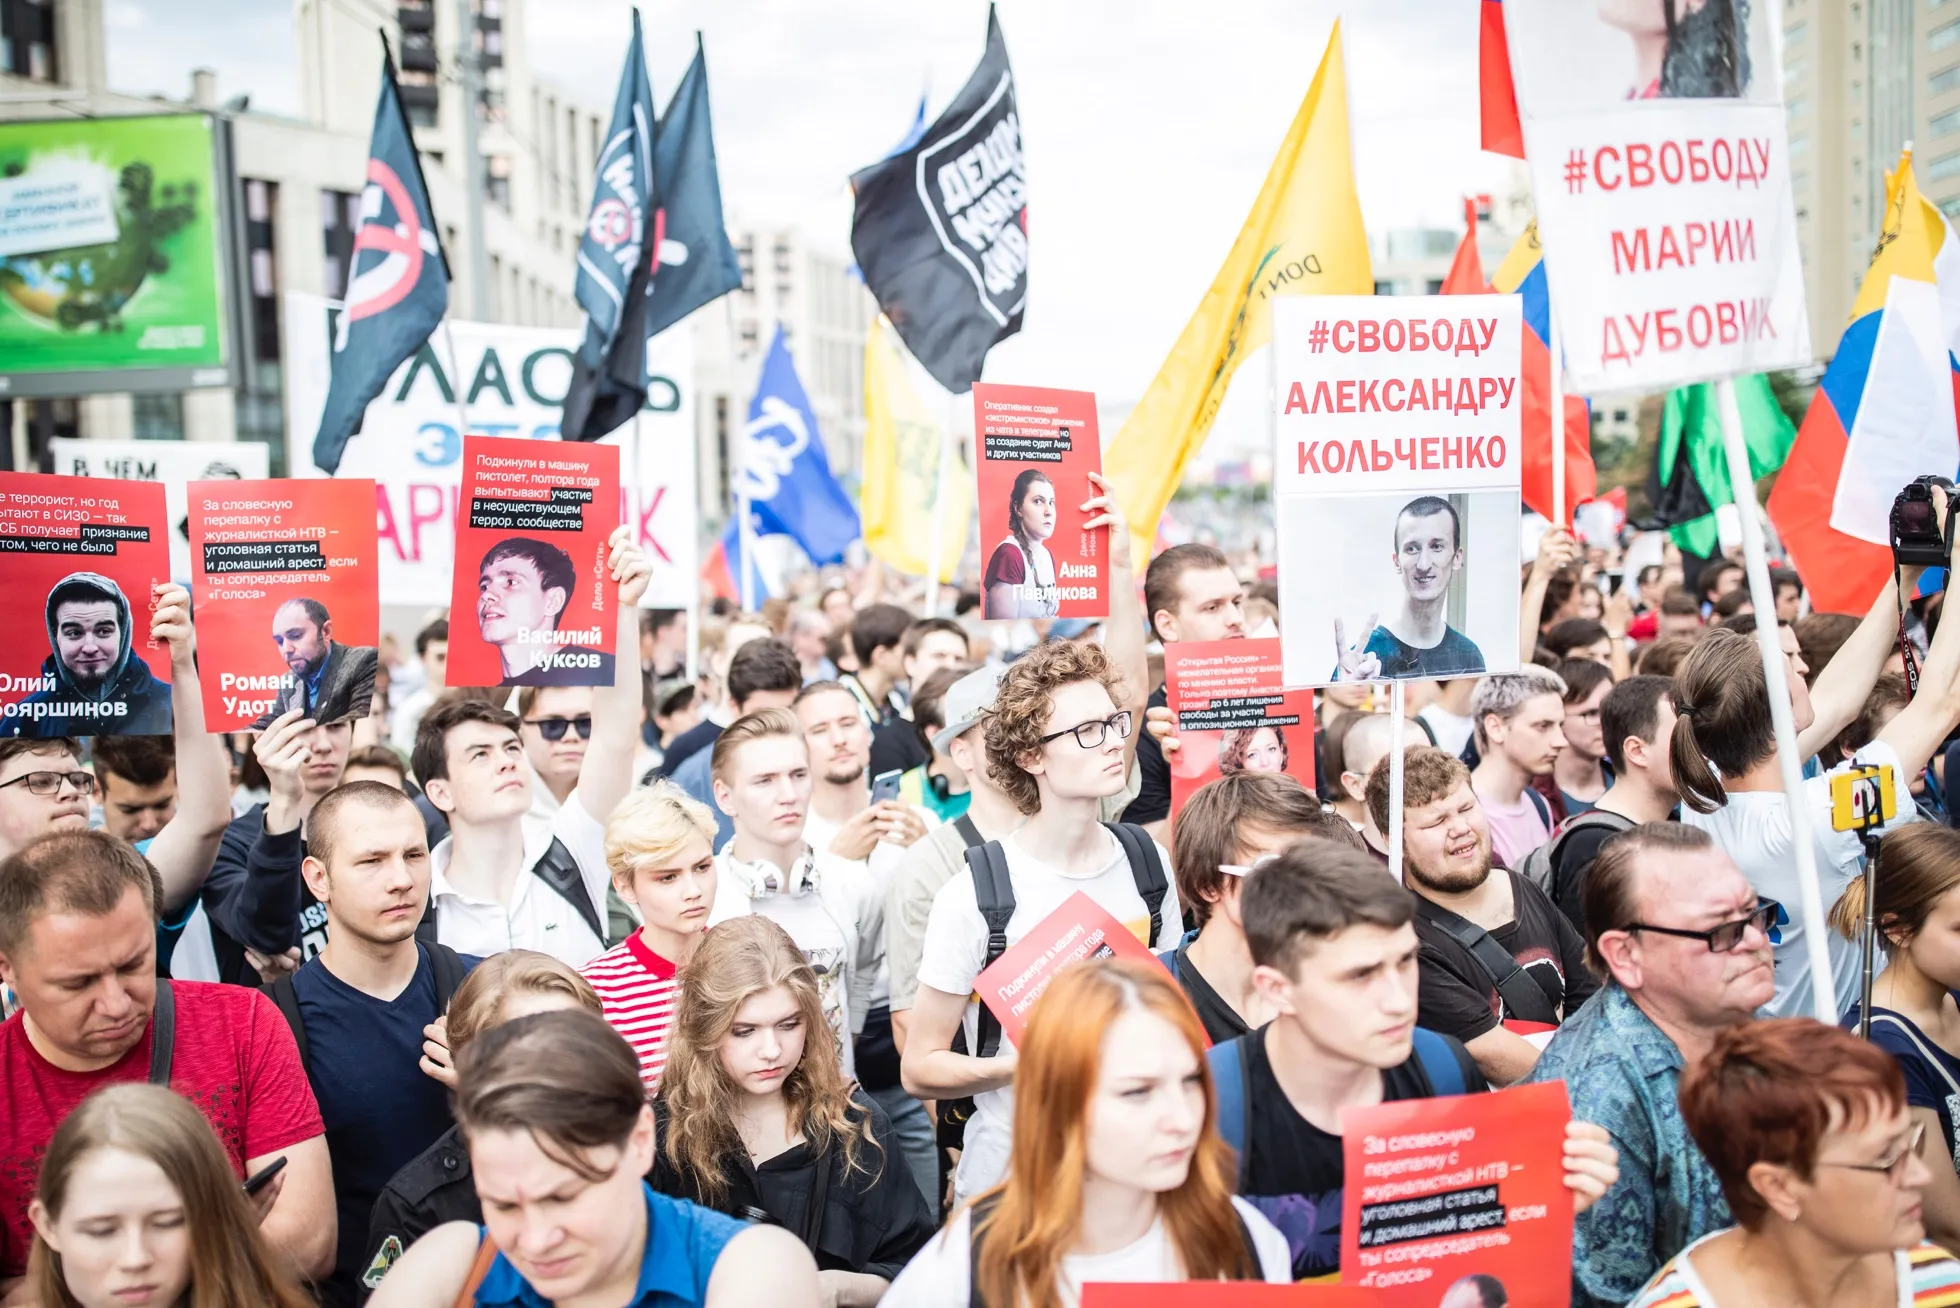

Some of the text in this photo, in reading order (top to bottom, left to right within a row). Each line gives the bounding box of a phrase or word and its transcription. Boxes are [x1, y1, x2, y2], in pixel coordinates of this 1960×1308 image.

[1564, 137, 1770, 195] #СВОБОДУ
[1610, 217, 1756, 276] МАРИИ
[1308, 318, 1498, 357] #СВОБОДУ
[1600, 296, 1778, 371] ДУБОВИК
[1284, 377, 1516, 416] АЛЕКСАНДРУ
[996, 439, 1031, 448] создание
[1032, 440, 1052, 449] судят
[1053, 440, 1072, 450] Анну
[476, 454, 589, 473] Подкинули в машину
[993, 451, 1018, 460] других
[1019, 451, 1061, 460] участников
[1297, 435, 1507, 475] КОЛЬЧЕНКО
[475, 471, 600, 488] пистолет, полтора года
[9, 493, 78, 508] террорист,
[80, 497, 96, 507] но
[98, 498, 119, 510] год
[474, 486, 592, 503] выпытывают участие
[203, 499, 293, 511] За словесную
[473, 501, 581, 515] в несуществующем
[43, 511, 51, 520] в
[53, 509, 90, 522] СИЗО
[106, 514, 127, 524] так
[203, 513, 282, 527] перепалку с
[472, 515, 582, 530] террор. сообществе
[21, 524, 79, 538] получает
[82, 526, 148, 541] признание
[204, 527, 297, 542] журналисткой
[299, 526, 326, 539] НТВ
[30, 541, 60, 552] чего
[62, 542, 78, 552] не
[80, 540, 114, 553] было
[205, 542, 317, 558] уголовная статья
[206, 556, 359, 572] и домашний арест, если
[1059, 561, 1097, 578] Анна
[208, 573, 331, 587] ты сопредседатель
[592, 541, 604, 611] Дело «Сети»
[208, 588, 266, 600] «Голоса»
[1012, 584, 1097, 601] Павликова
[517, 626, 602, 646] Василий
[529, 650, 601, 672] Куксов
[220, 672, 294, 692] Роман
[1179, 689, 1211, 699] Только
[1223, 698, 1229, 707] 6
[1230, 698, 1245, 706] лет
[1246, 696, 1283, 706] лишения
[221, 696, 277, 718] Удот
[1180, 707, 1265, 720] свободы за участие
[1188, 719, 1256, 730] оппозиционном
[1257, 715, 1299, 728] движении
[1083, 927, 1105, 956] года
[997, 951, 1048, 1001] Подкинули
[1053, 922, 1086, 955] машину
